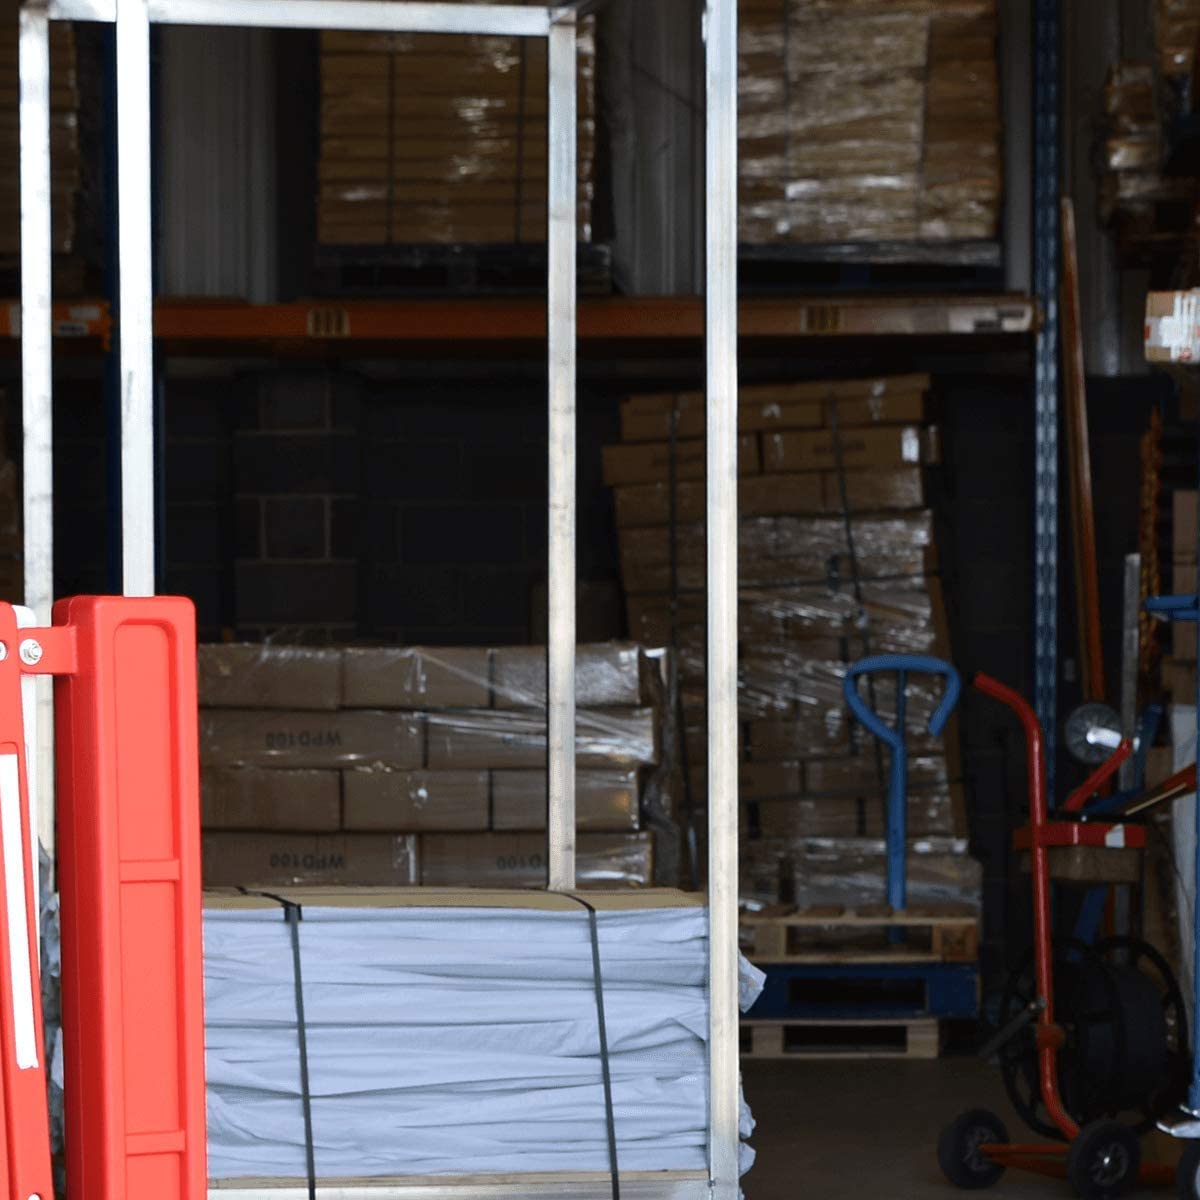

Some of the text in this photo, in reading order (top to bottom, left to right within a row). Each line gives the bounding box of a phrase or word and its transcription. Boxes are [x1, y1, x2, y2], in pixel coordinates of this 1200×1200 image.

[265, 731, 343, 748] WPD100
[270, 853, 345, 870] WPD100
[496, 854, 548, 871] D100
